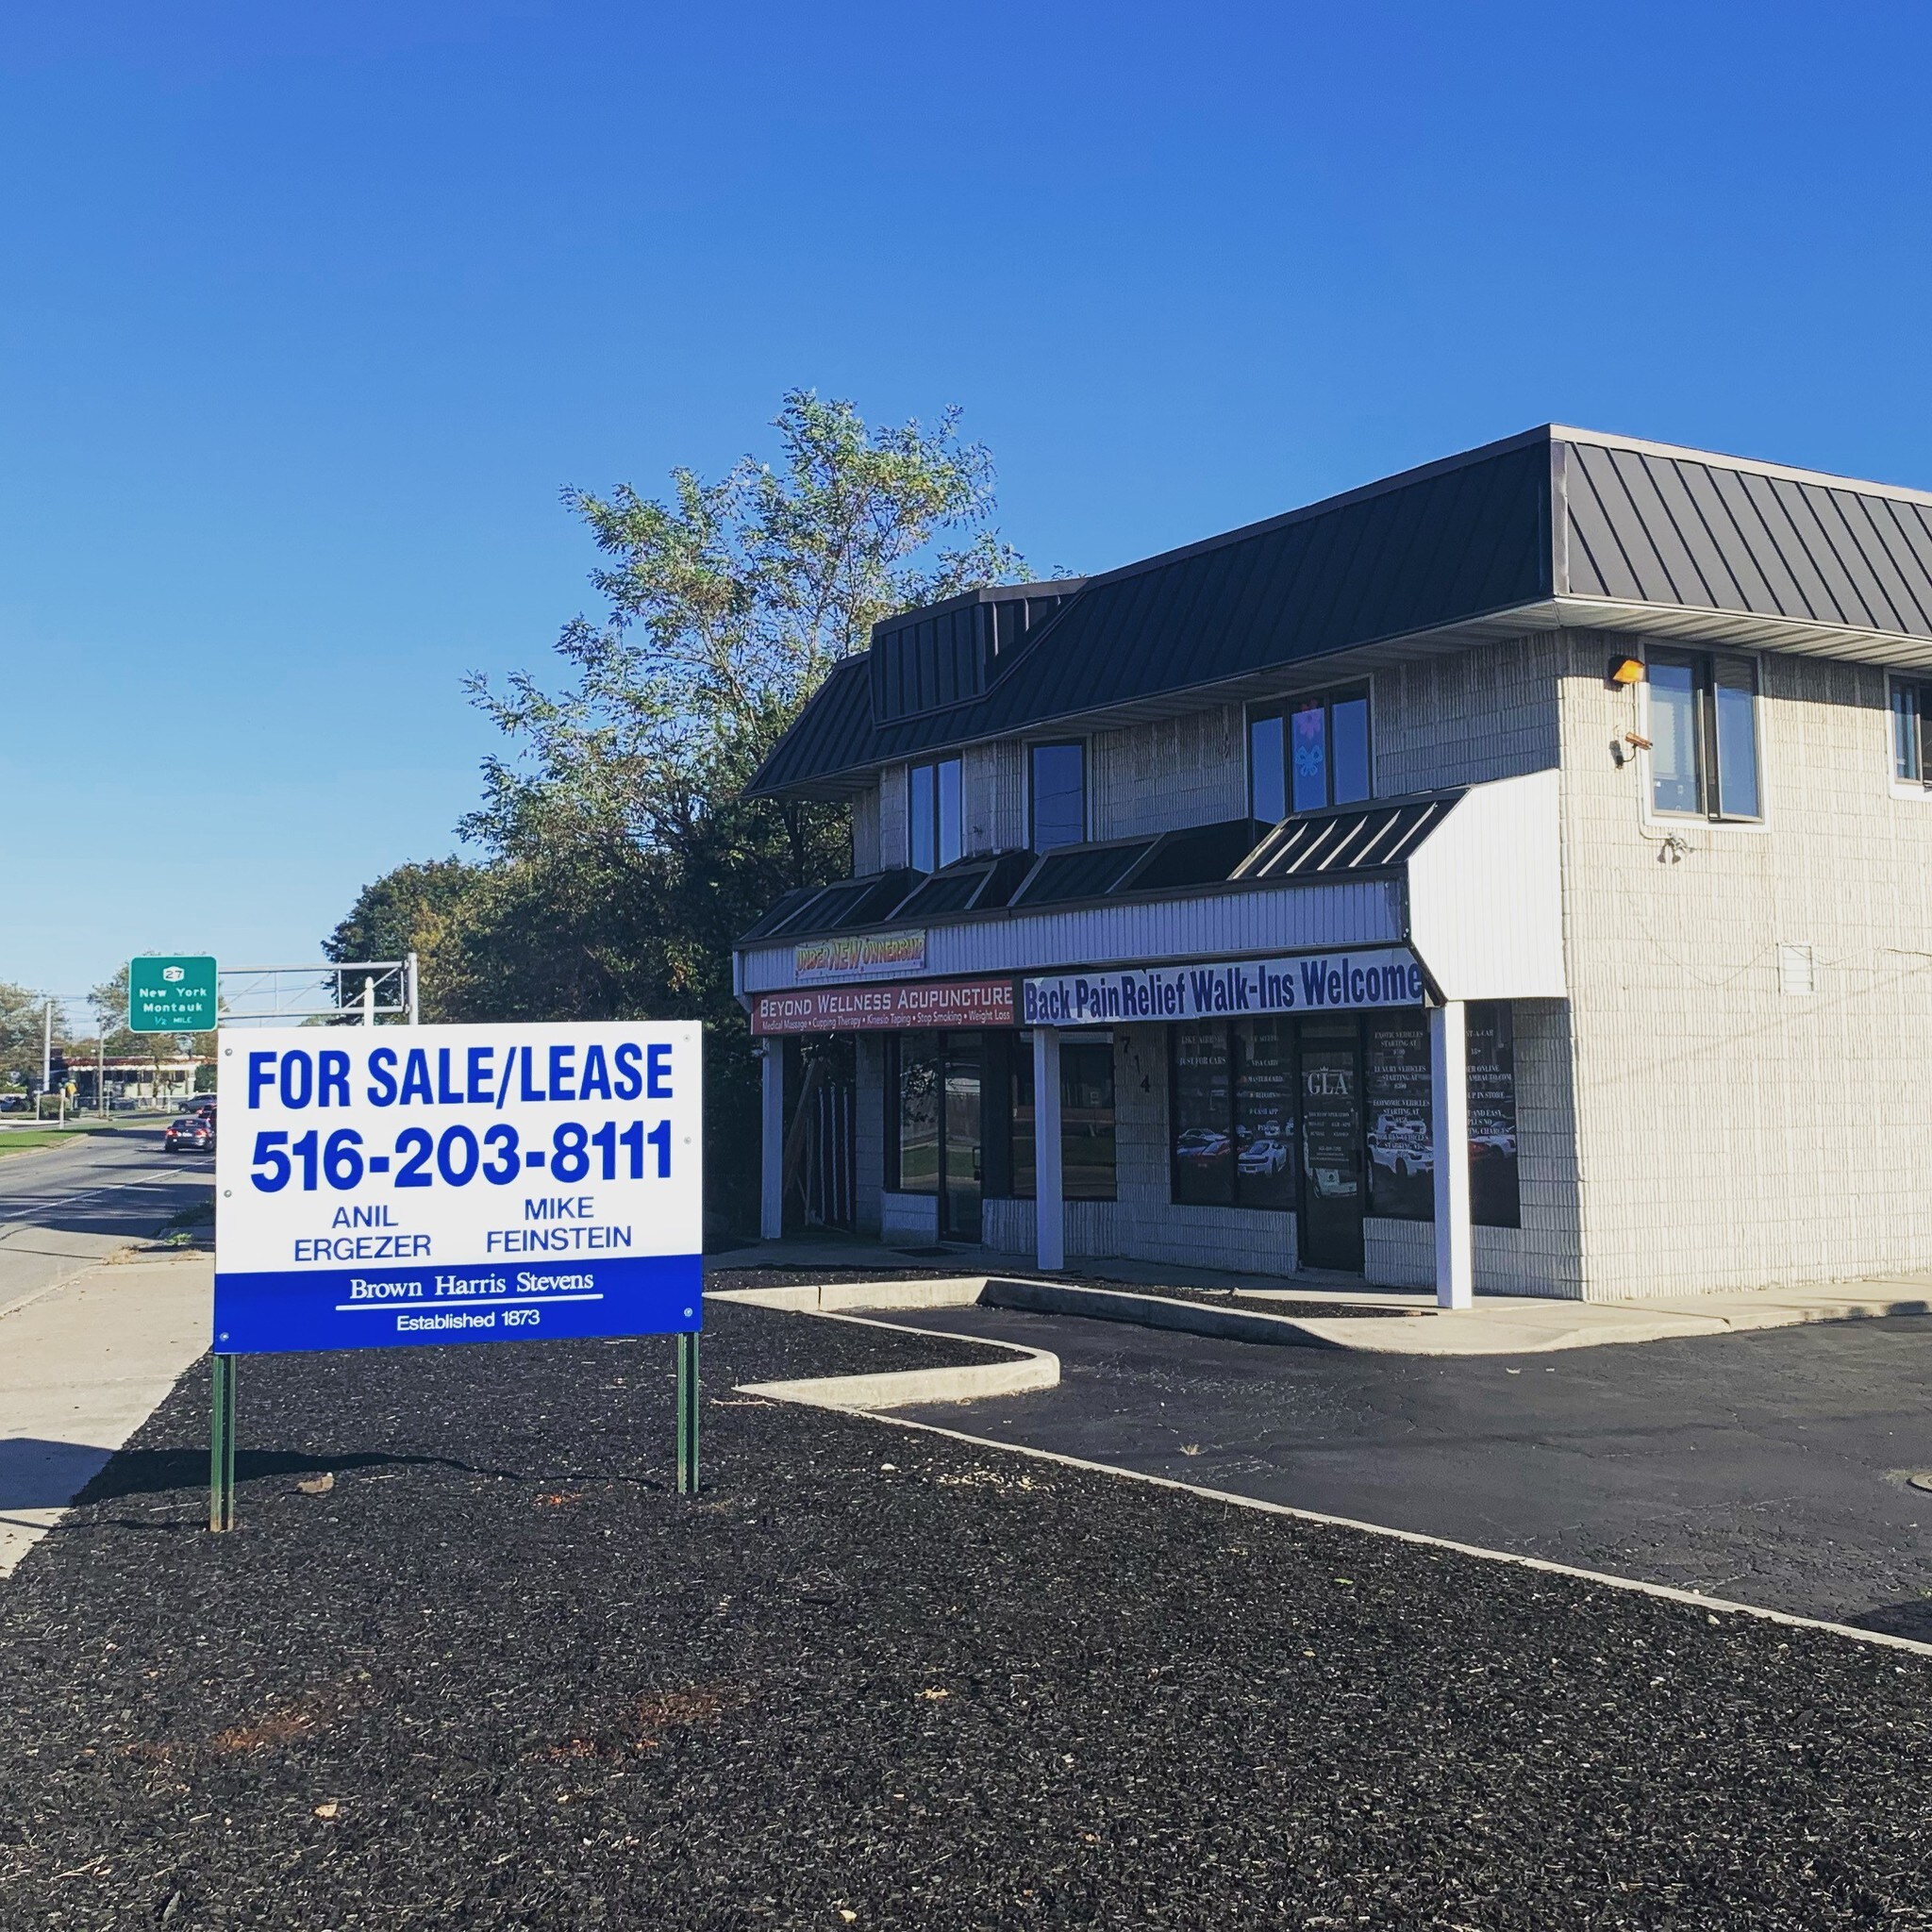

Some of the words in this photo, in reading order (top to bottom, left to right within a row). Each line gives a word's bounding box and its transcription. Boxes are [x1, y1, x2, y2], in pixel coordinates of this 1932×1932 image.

[797, 947, 830, 972] UNDER
[829, 939, 862, 971] NEW
[861, 938, 924, 964] OWNERSHIP
[165, 970, 183, 979] 27
[139, 988, 167, 998] New
[175, 987, 207, 997] York
[1024, 980, 1071, 1020] Back
[1075, 977, 1120, 1018] Pain
[1121, 973, 1186, 1016] Relief
[1191, 965, 1294, 1012] Walk-Ins
[1301, 958, 1422, 1006] Welcome
[142, 1003, 203, 1012] Montauk
[760, 998, 811, 1018] BEYOND
[818, 993, 891, 1013] WELLNESS
[897, 987, 1013, 1009] ACUPUNCTURE
[762, 1020, 783, 1030] Medical
[784, 1020, 808, 1031] Massage
[812, 1017, 836, 1029] Cupping
[838, 1015, 861, 1027] Therapy
[867, 1014, 889, 1025] Kinesio
[891, 1013, 911, 1026] Taping
[917, 1012, 932, 1025] Stop
[933, 1010, 962, 1024] Smoking
[968, 1009, 993, 1024] Weight
[994, 1009, 1010, 1021] Loss
[247, 1048, 351, 1110] FOR
[367, 1042, 674, 1110] SALE/LEASE
[1307, 1072, 1349, 1095] GLA
[250, 1119, 672, 1193] 516-203-8111
[331, 1205, 399, 1228] ANIL
[525, 1196, 594, 1220] MIKE
[294, 1234, 432, 1262] ERGEZER
[487, 1225, 632, 1254] FEINSTEIN
[350, 1279, 424, 1300] Brown
[435, 1274, 507, 1296] Harris
[516, 1272, 594, 1293] Stevens
[396, 1311, 496, 1332] Established
[502, 1309, 541, 1327] 1873
